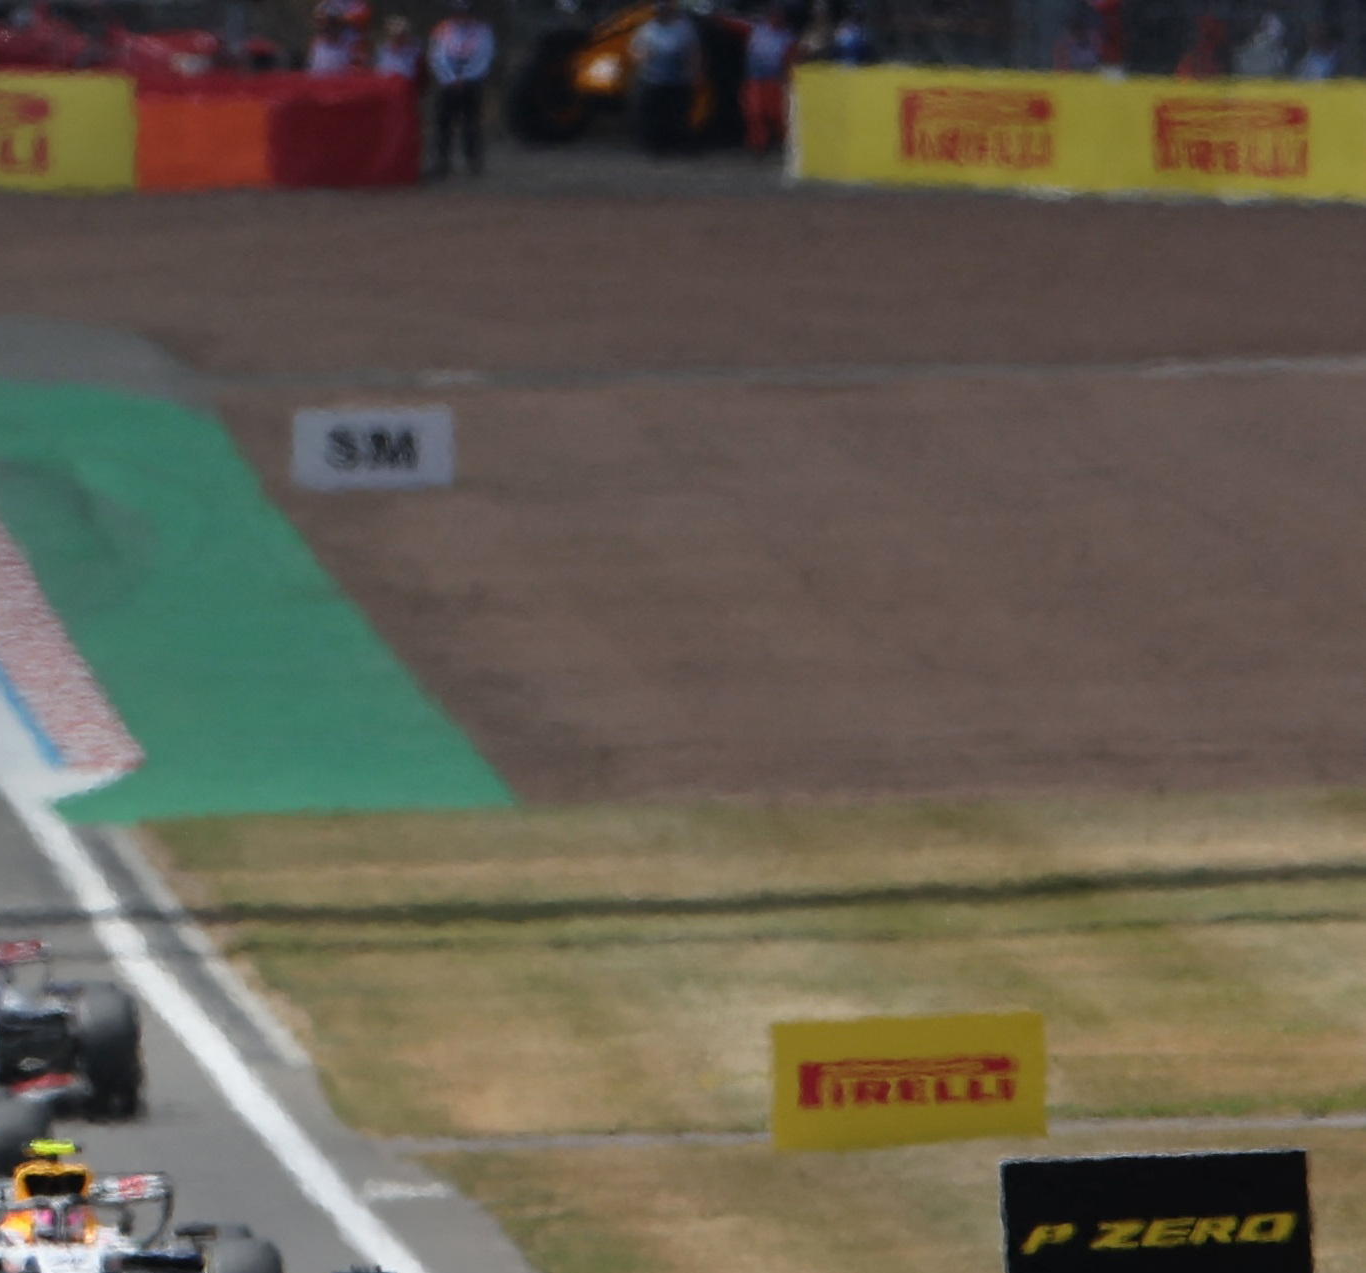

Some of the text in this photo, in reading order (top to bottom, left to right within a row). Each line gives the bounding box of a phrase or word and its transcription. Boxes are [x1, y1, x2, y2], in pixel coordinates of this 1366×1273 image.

[899, 87, 1055, 167] PIRELLI
[1151, 98, 1309, 178] PIRELLI
[324, 424, 420, 472] SM
[798, 1056, 1018, 1108] PIRELLI
[1022, 1211, 1297, 1255] P ZERO
